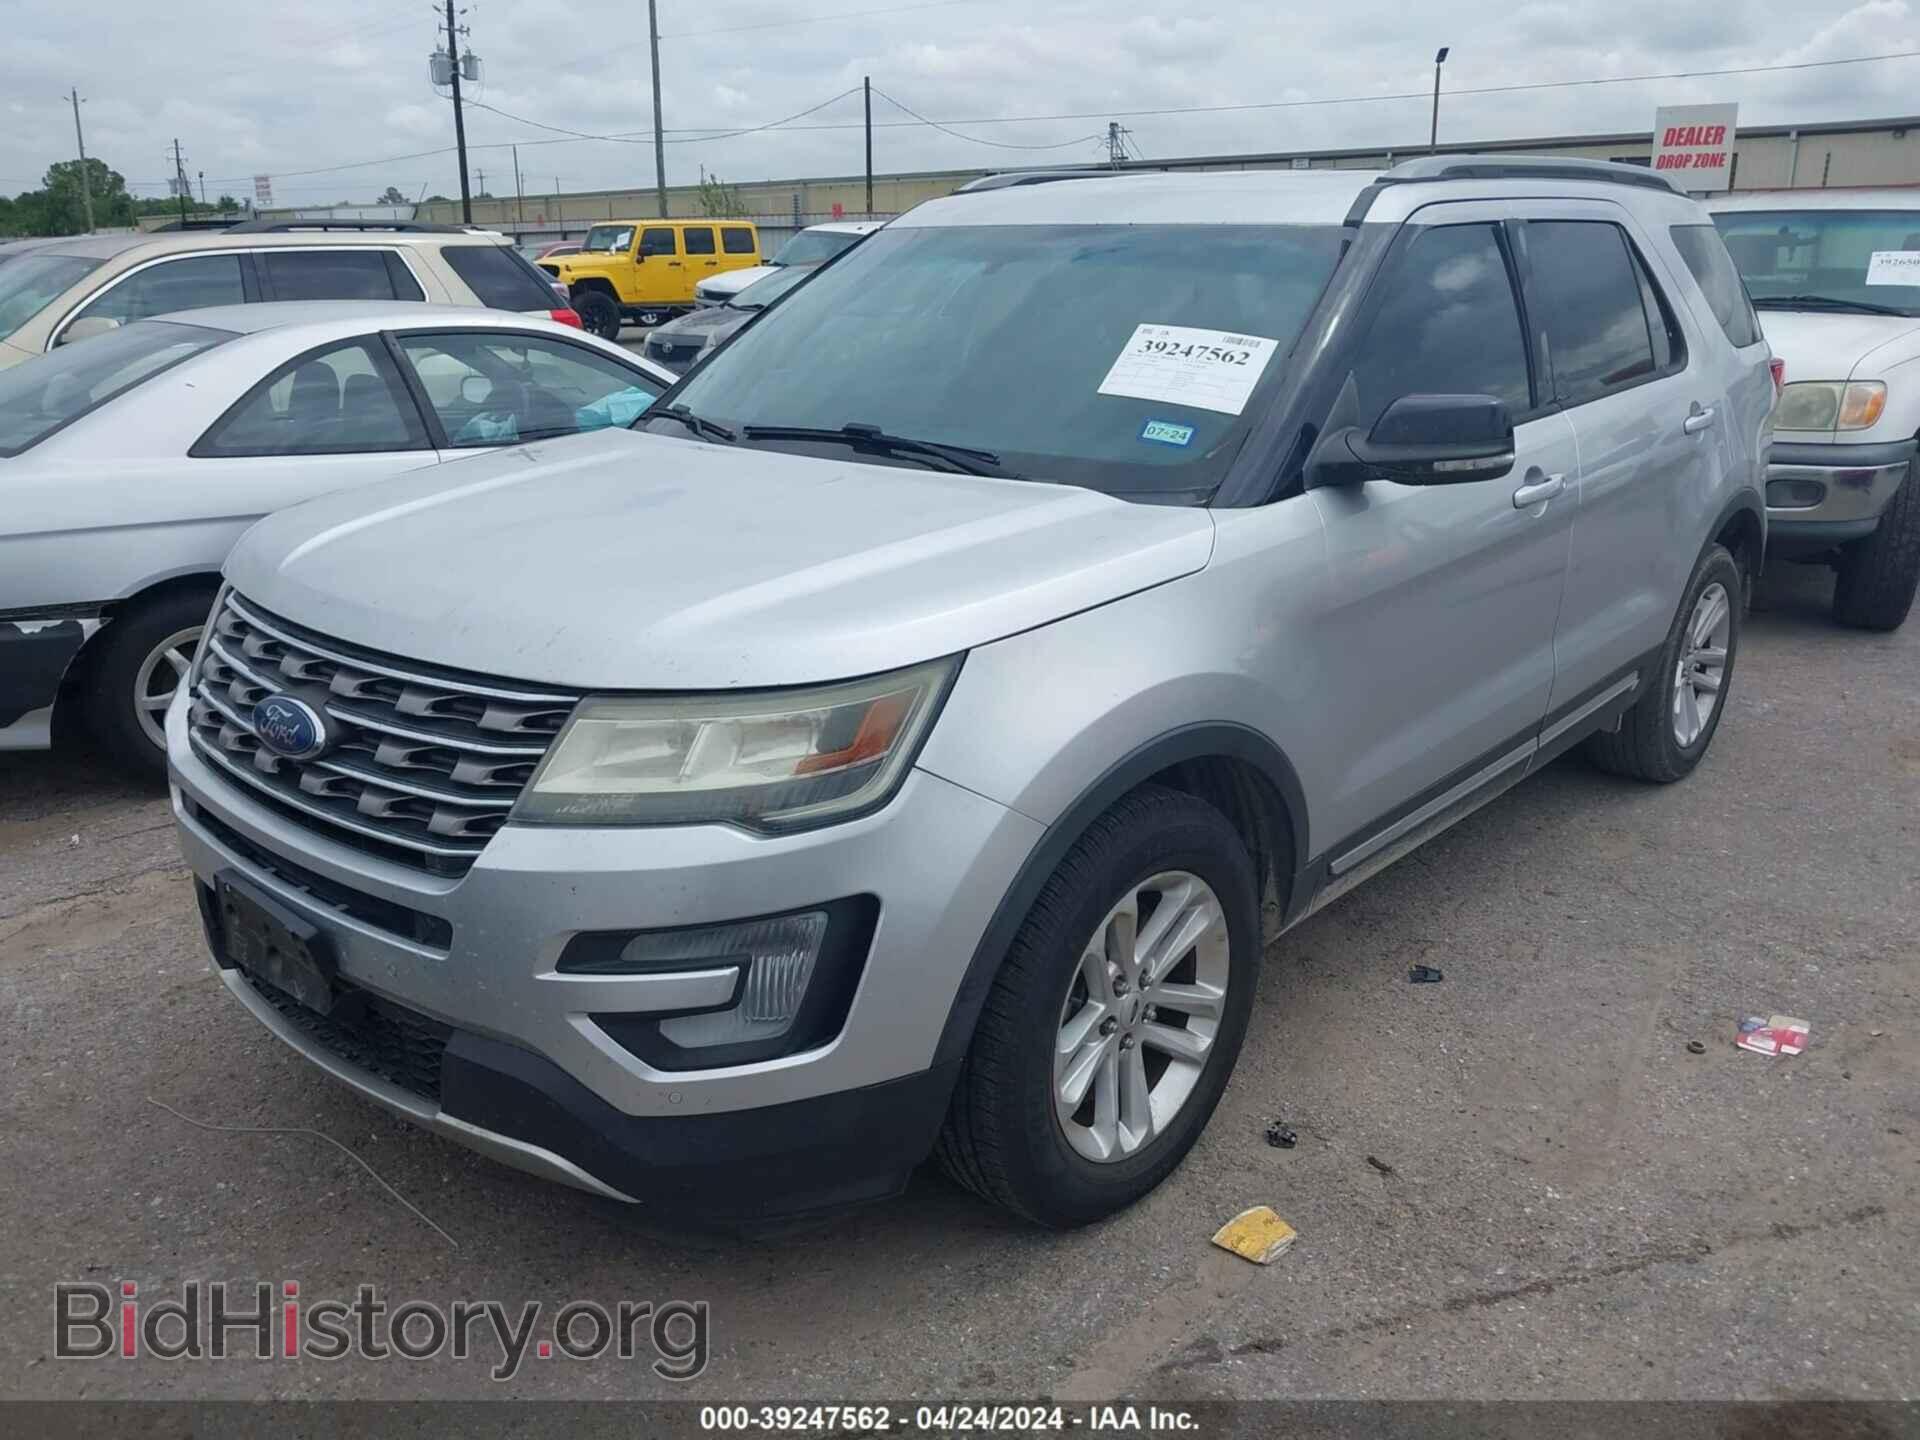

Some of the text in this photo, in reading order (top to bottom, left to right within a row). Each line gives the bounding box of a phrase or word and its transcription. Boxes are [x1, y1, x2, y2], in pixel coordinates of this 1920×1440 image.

[1663, 126, 1726, 147] DEALER
[1655, 152, 1727, 170] DROP ZONE
[1137, 339, 1251, 366] 39247562
[261, 704, 300, 745] Ford
